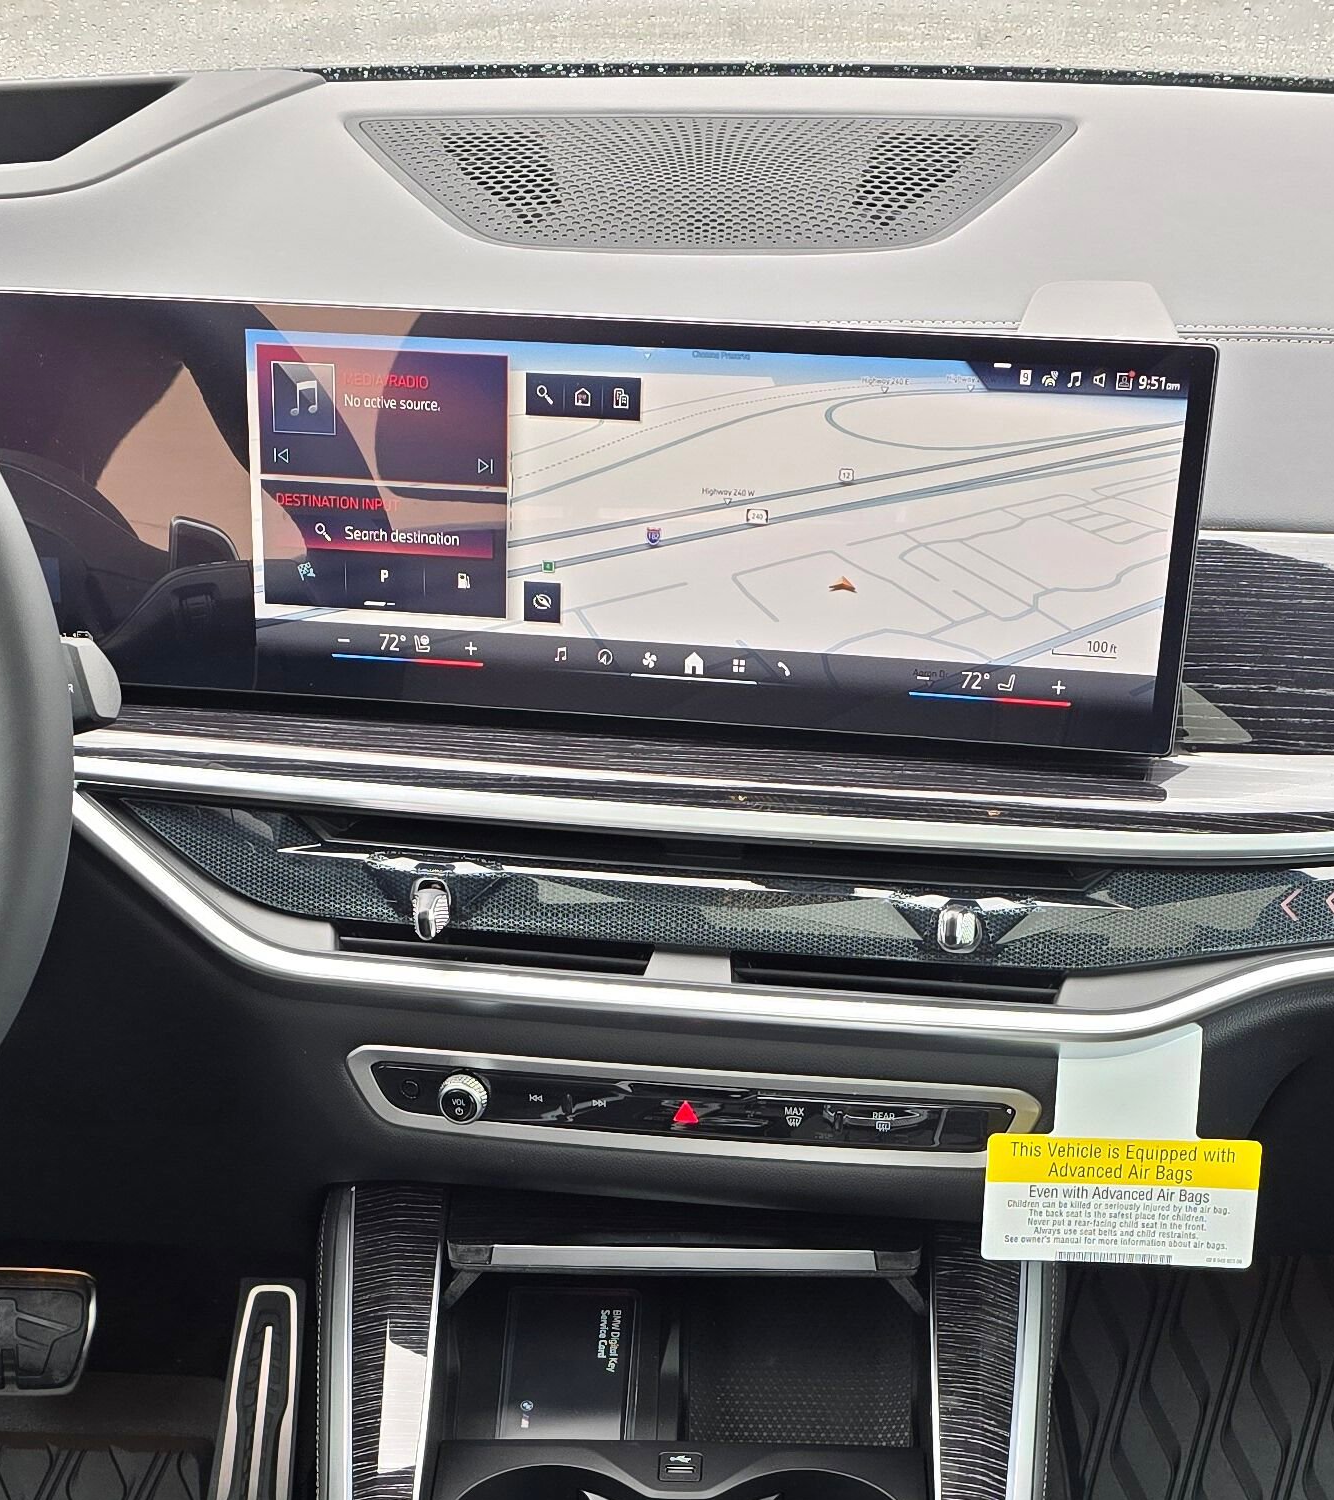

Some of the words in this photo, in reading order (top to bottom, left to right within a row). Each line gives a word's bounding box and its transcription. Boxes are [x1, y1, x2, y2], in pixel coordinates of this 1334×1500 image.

[344, 394, 360, 407] No
[364, 396, 397, 409] active
[400, 400, 441, 412] source.
[702, 488, 732, 496] Highway
[734, 489, 746, 497] 240
[276, 492, 360, 510] DESTINATION
[362, 498, 399, 512] INPUT
[752, 513, 764, 521] 240
[345, 526, 387, 542] Search
[390, 529, 460, 546] destination
[380, 569, 389, 583] P
[1087, 641, 1109, 654] 100
[1111, 643, 1117, 654] ft
[452, 1098, 466, 1106] VOL
[784, 1106, 805, 1117] MAX
[872, 1112, 895, 1121] REAR
[1011, 1142, 1042, 1158] This
[1048, 1142, 1102, 1159] Vehicle
[1108, 1144, 1120, 1159] is
[1126, 1144, 1198, 1164] Equipped
[1204, 1147, 1236, 1163] with
[1048, 1162, 1122, 1179] Advanced
[1128, 1164, 1150, 1180] Air
[1156, 1165, 1193, 1184] Bags
[1029, 1185, 1058, 1198] Even
[1063, 1186, 1088, 1199] with
[1092, 1186, 1153, 1202] Advanced
[1157, 1189, 1175, 1202] Air
[1179, 1189, 1210, 1206] Bags
[1007, 1200, 1040, 1208] Children
[1042, 1201, 1056, 1209] can
[1058, 1201, 1068, 1209] be
[1070, 1200, 1091, 1209] killed
[1104, 1202, 1140, 1213] seriously
[1143, 1202, 1170, 1213] injured
[1173, 1204, 1182, 1214] by
[1186, 1204, 1198, 1212] the
[1200, 1205, 1211, 1213] air
[1213, 1206, 1231, 1216] bag.
[1029, 1209, 1043, 1217] The
[1046, 1209, 1064, 1217] back
[1066, 1210, 1082, 1218] seat
[1085, 1210, 1091, 1218] is
[1094, 1210, 1107, 1218] the
[1109, 1211, 1133, 1220] safest
[1135, 1212, 1155, 1221] place
[1158, 1212, 1169, 1220] for
[1172, 1212, 1207, 1223] children.
[1028, 1218, 1052, 1226] Never
[1052, 1218, 1065, 1227] put
[1074, 1219, 1117, 1230] rear-facing
[1119, 1220, 1138, 1228] child
[1141, 1221, 1157, 1229] seat
[1170, 1221, 1182, 1230] the
[1185, 1222, 1207, 1231] front.
[1033, 1227, 1061, 1236] Always
[1064, 1228, 1077, 1236] use
[1079, 1227, 1096, 1236] seat
[1098, 1228, 1117, 1237] belts
[1120, 1229, 1134, 1237] and
[1137, 1229, 1156, 1238] child
[1158, 1230, 1199, 1240] restraints.
[1004, 1235, 1019, 1243] See
[1021, 1235, 1051, 1244] owner's
[1053, 1236, 1082, 1244] manual
[1084, 1236, 1096, 1244] for
[1120, 1238, 1166, 1247] information
[1168, 1240, 1191, 1248] about
[1193, 1241, 1204, 1249] air
[1207, 1241, 1228, 1251] bags.
[599, 1310, 610, 1339] Service
[611, 1310, 622, 1331] BMW
[597, 1340, 608, 1359] Card
[609, 1331, 620, 1357] Digital
[606, 1358, 618, 1373] Key
